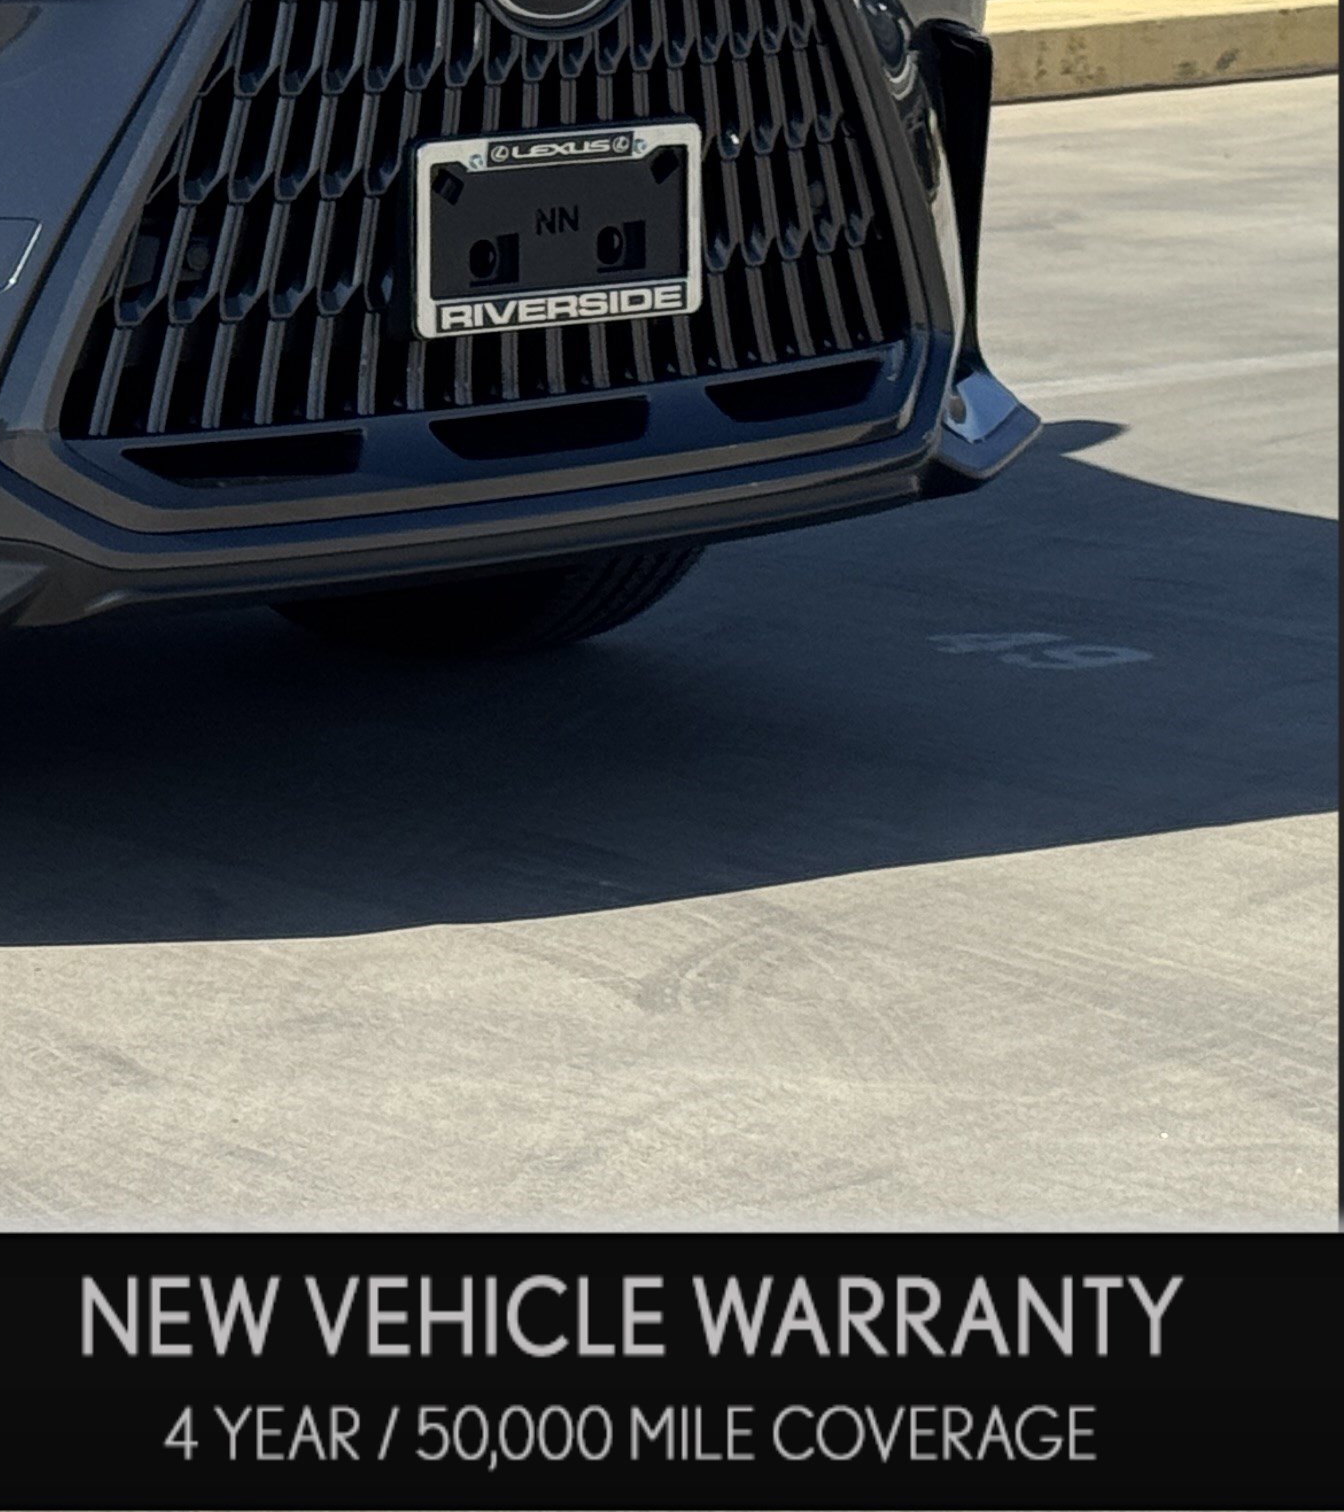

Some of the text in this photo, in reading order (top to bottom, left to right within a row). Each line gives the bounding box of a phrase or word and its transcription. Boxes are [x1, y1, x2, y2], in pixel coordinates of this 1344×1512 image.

[512, 140, 611, 159] LEXUS
[535, 205, 579, 235] NN
[441, 285, 683, 330] RIVERSIDE
